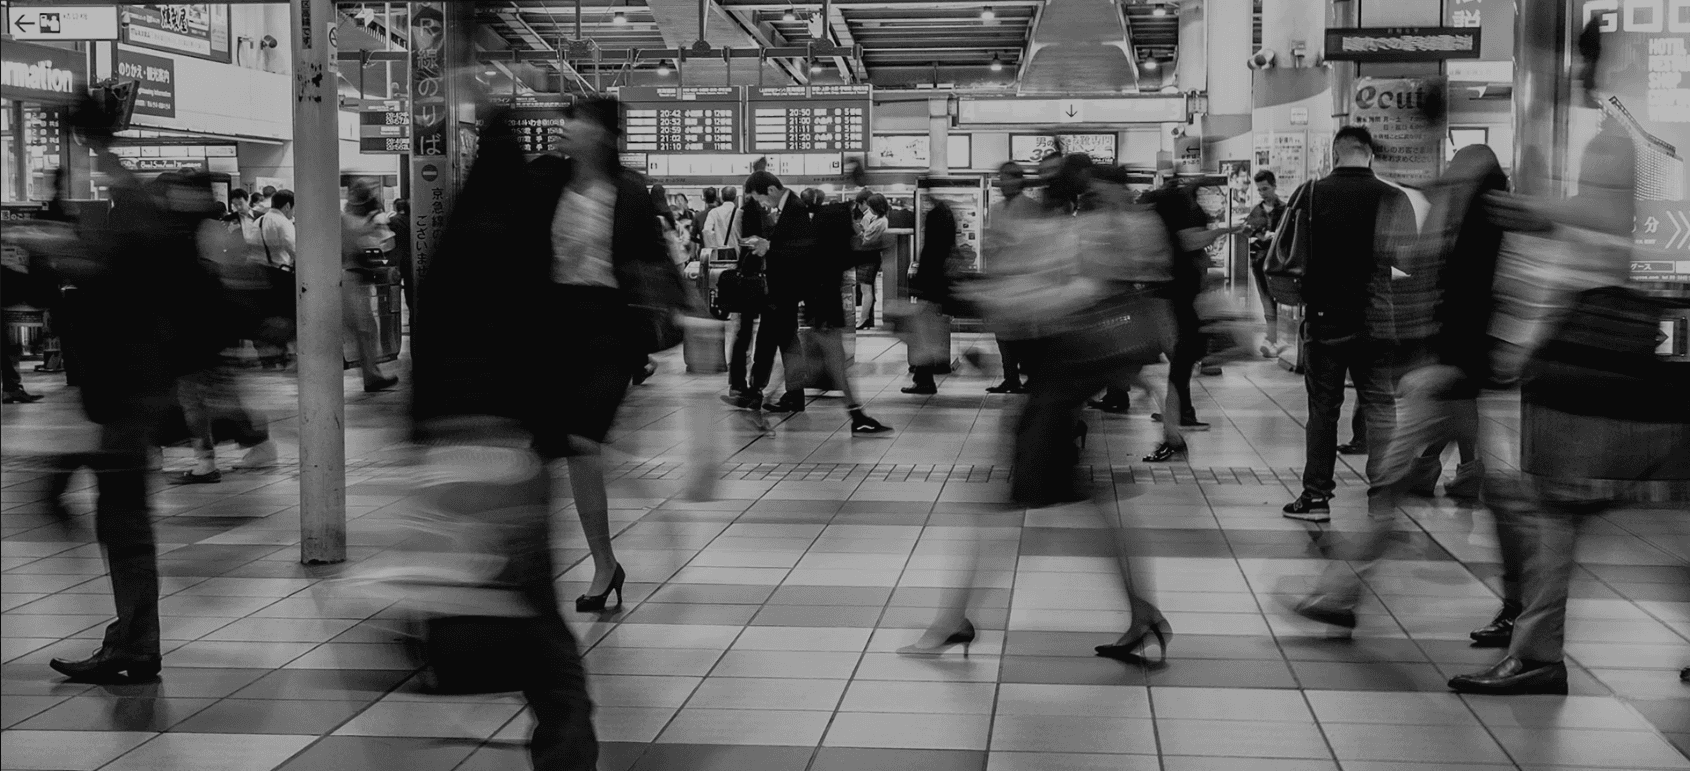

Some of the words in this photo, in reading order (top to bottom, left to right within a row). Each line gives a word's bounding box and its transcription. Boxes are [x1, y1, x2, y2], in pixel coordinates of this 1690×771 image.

[789, 108, 811, 116] 20:50
[789, 125, 811, 133] 21:11
[660, 134, 682, 142] 21:02
[789, 133, 811, 141] 21:20
[660, 142, 682, 150] 21:10
